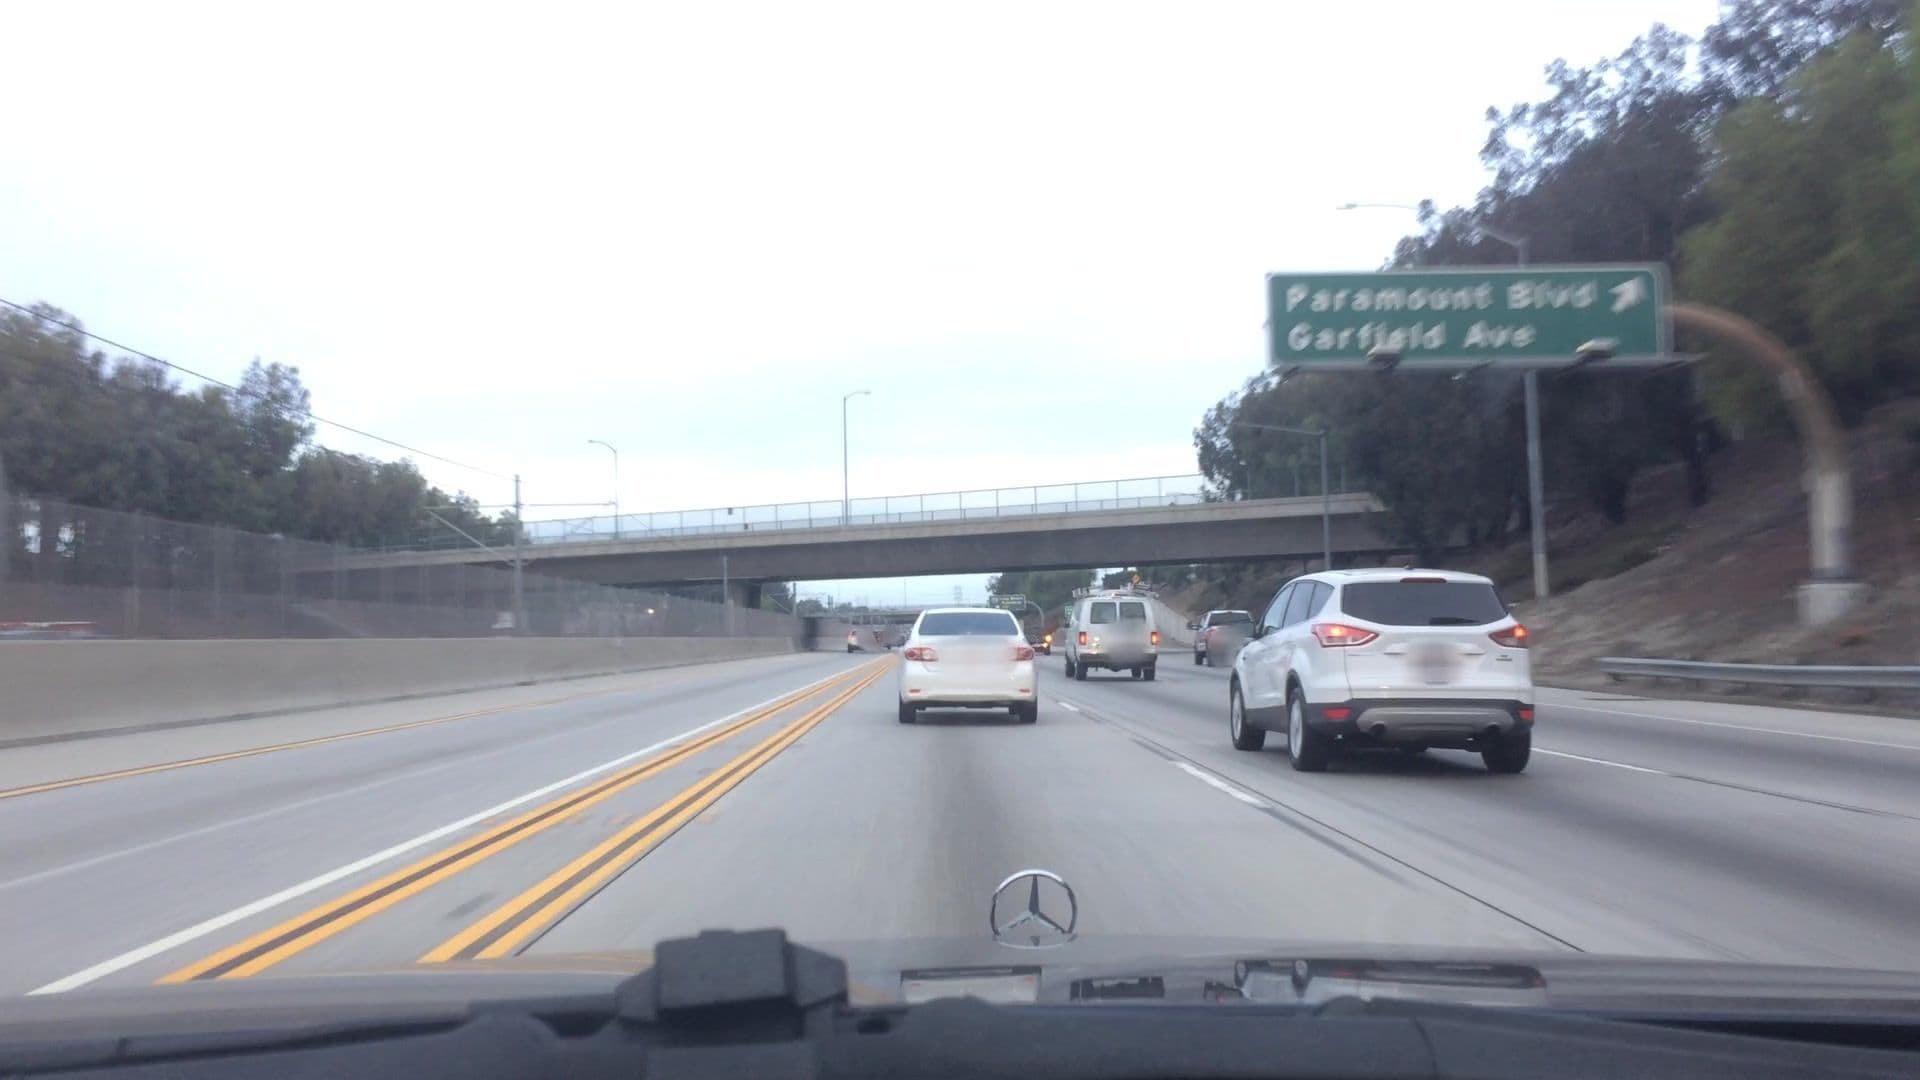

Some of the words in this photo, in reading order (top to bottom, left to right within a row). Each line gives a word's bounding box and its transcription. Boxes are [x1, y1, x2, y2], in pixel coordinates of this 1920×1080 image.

[1286, 282, 1493, 312] Paramount
[1507, 279, 1598, 309] Blvd
[1288, 321, 1446, 351] Garfield
[1463, 320, 1536, 348] Ave
